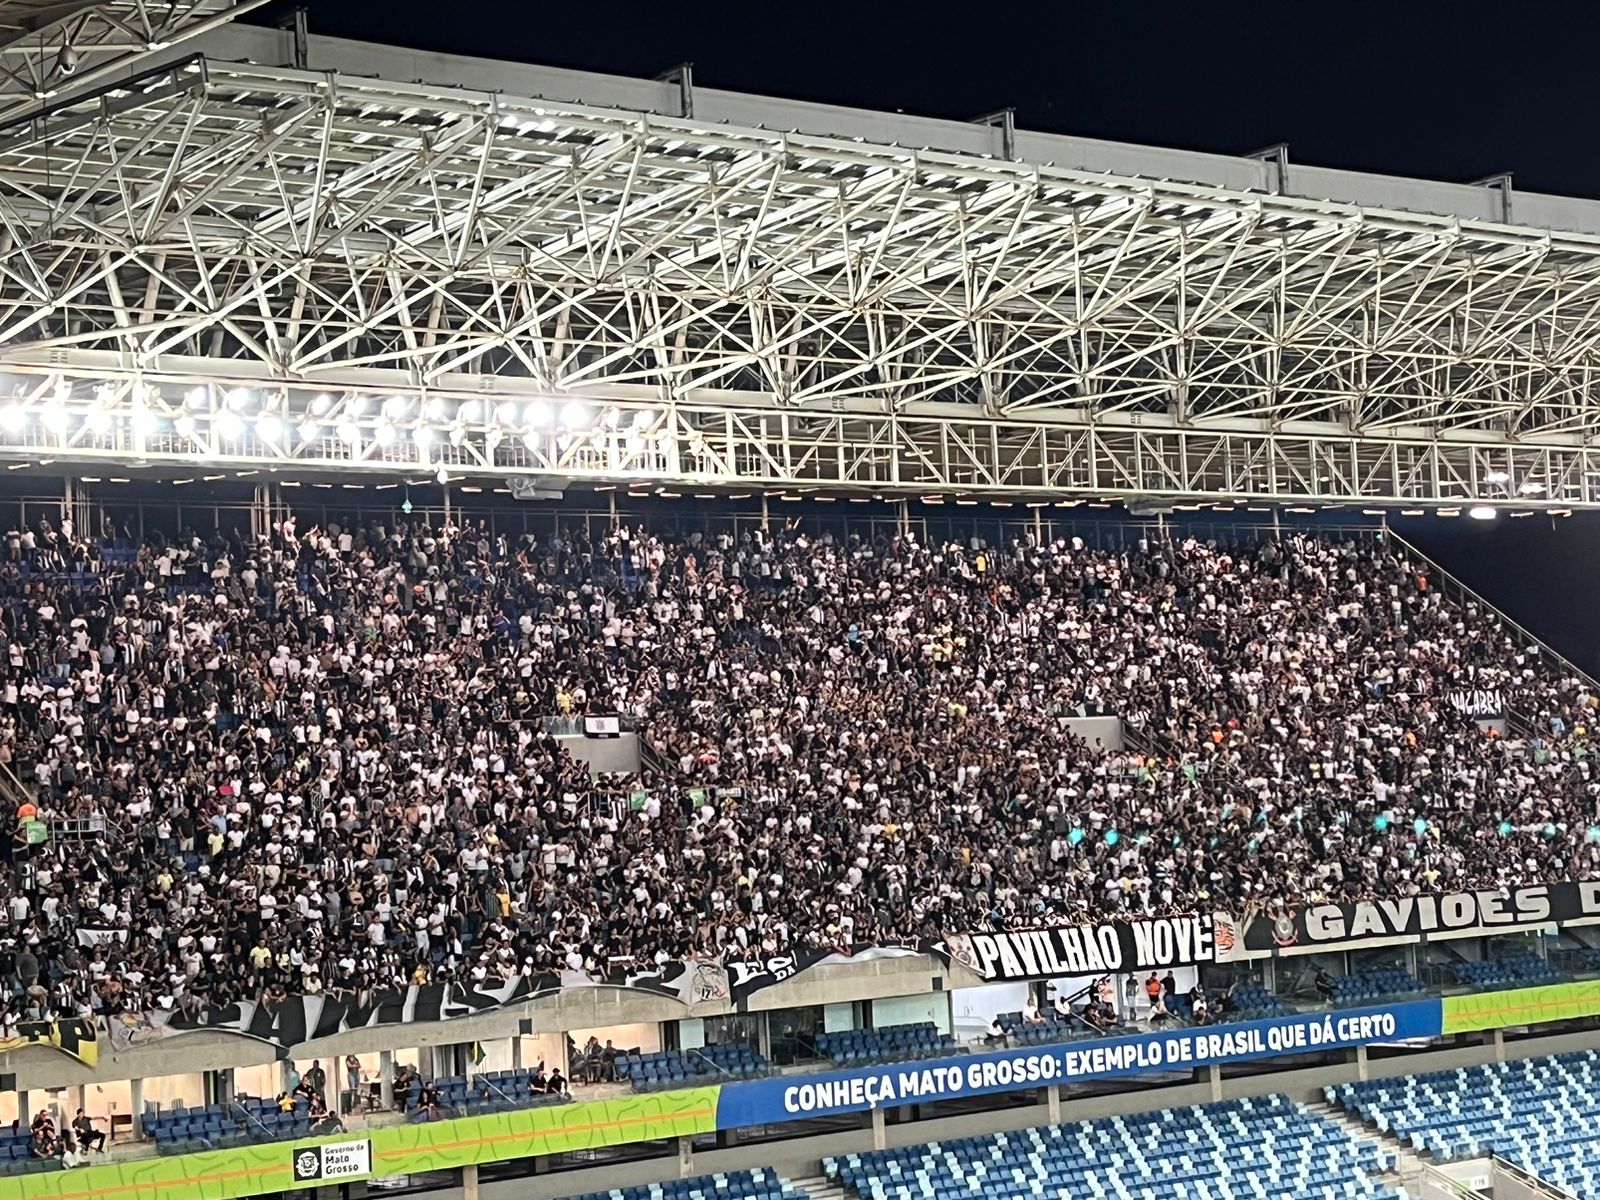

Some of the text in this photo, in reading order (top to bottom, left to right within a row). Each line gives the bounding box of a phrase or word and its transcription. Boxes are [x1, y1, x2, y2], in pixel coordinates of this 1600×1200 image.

[1132, 914, 1214, 967] NOVE
[785, 1012, 1396, 1112] CONHEÇA MATO GROSSO: EXEMPLO DE BRASIL QUE DÁ CERTO
[325, 1156, 350, 1165] Mato
[325, 1164, 359, 1174] Grosso
